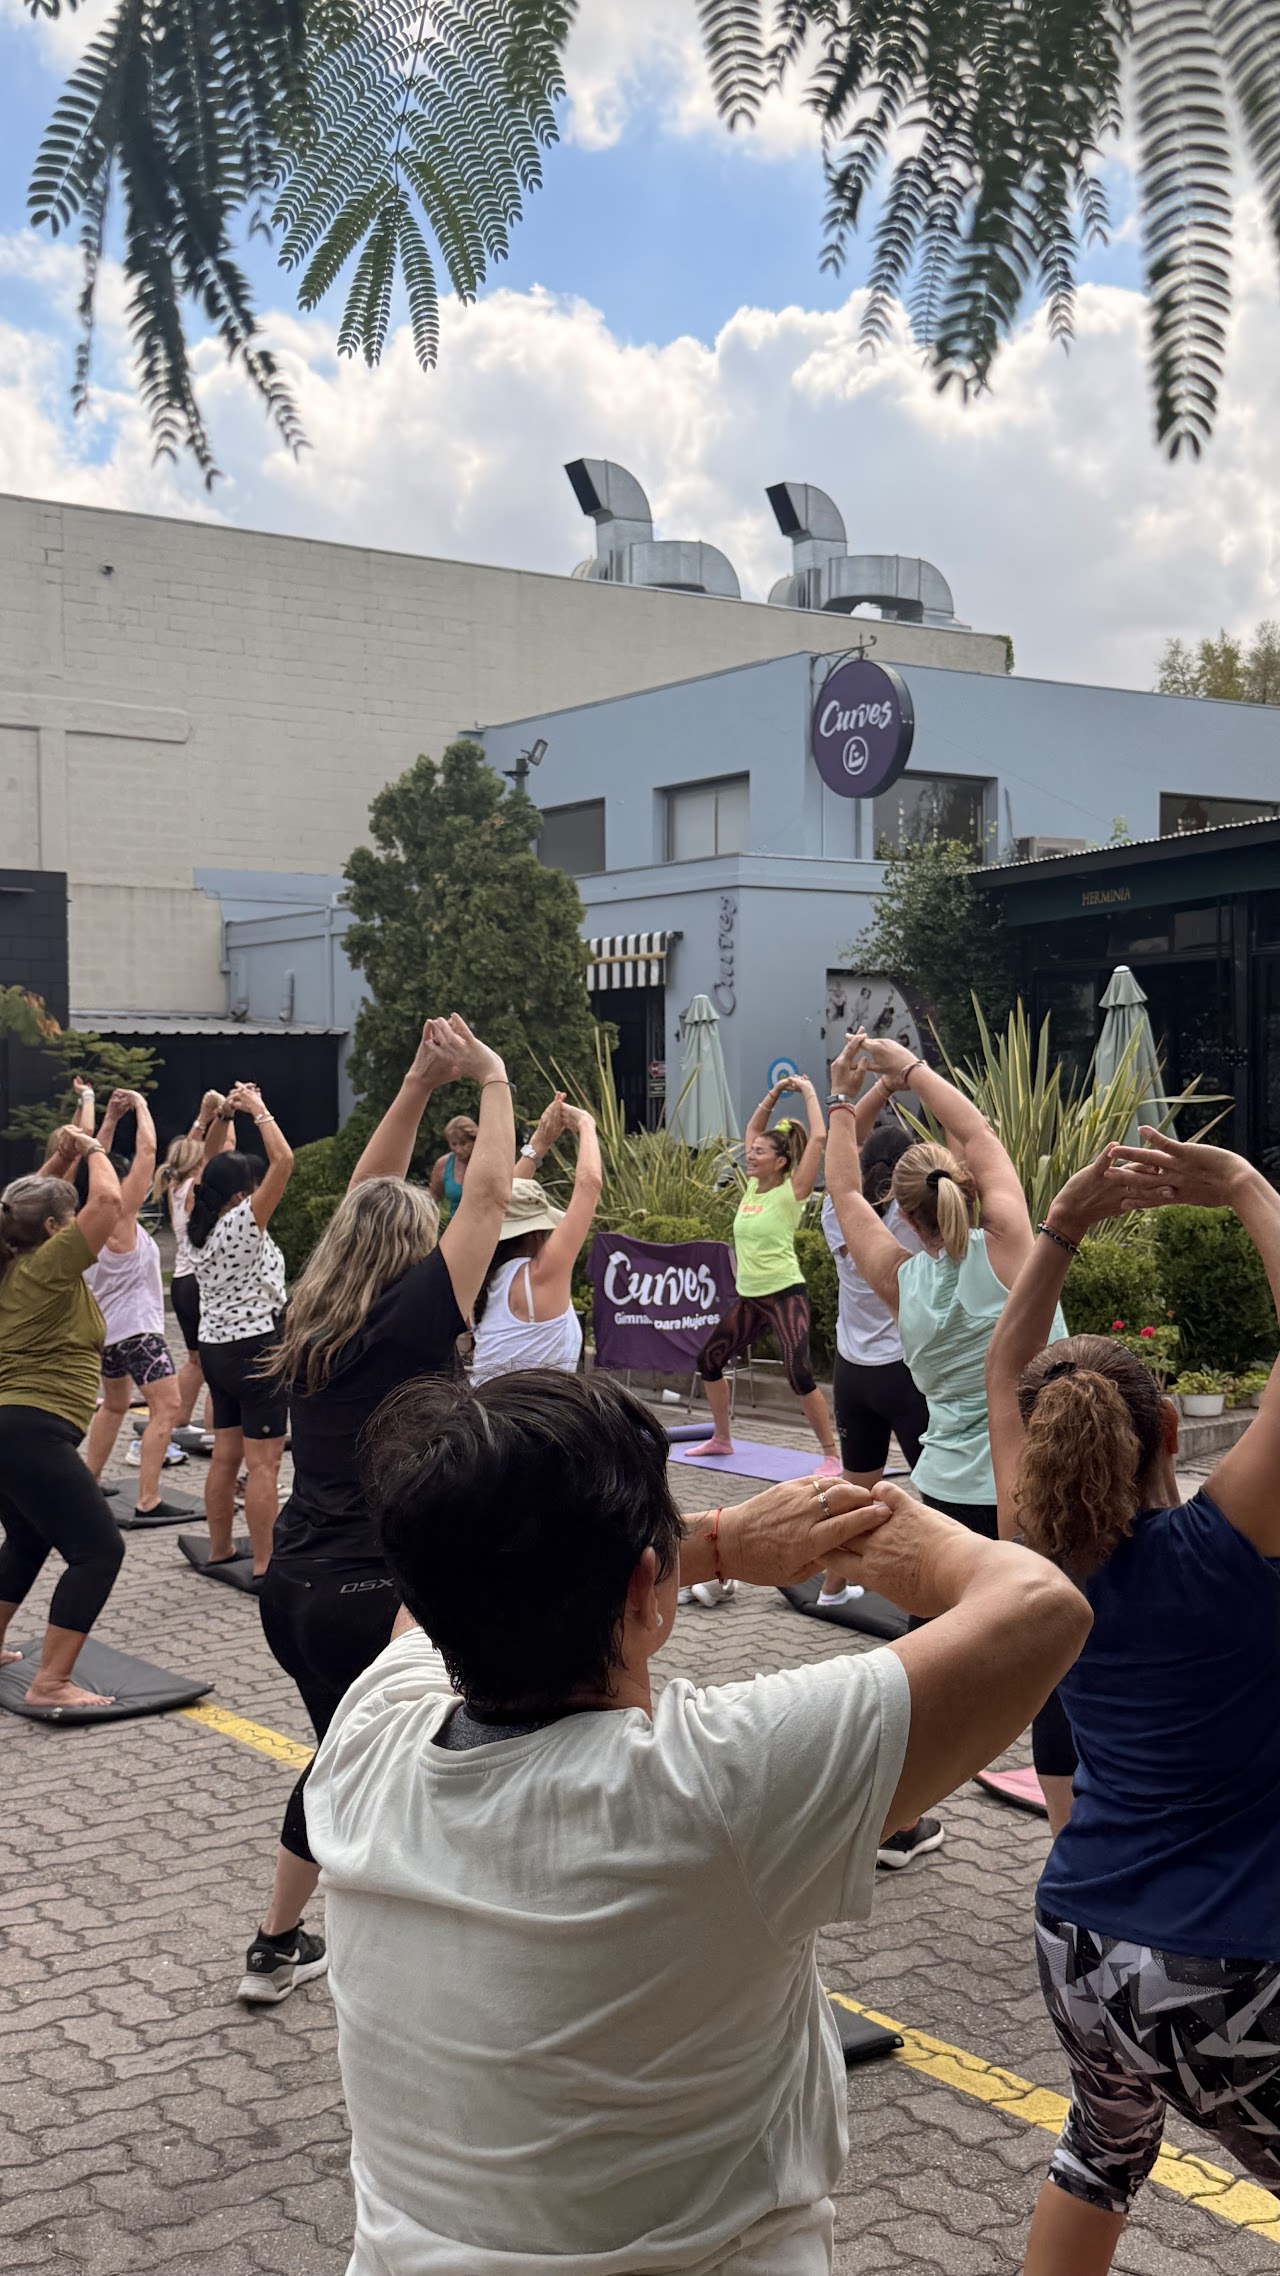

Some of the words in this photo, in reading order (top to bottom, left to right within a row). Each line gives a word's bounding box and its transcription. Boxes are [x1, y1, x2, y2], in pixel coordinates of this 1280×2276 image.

[819, 700, 892, 737] Curves
[1082, 887, 1131, 906] HERMINIA
[604, 1251, 716, 1310] Curves
[681, 1313, 721, 1331] Mujeres
